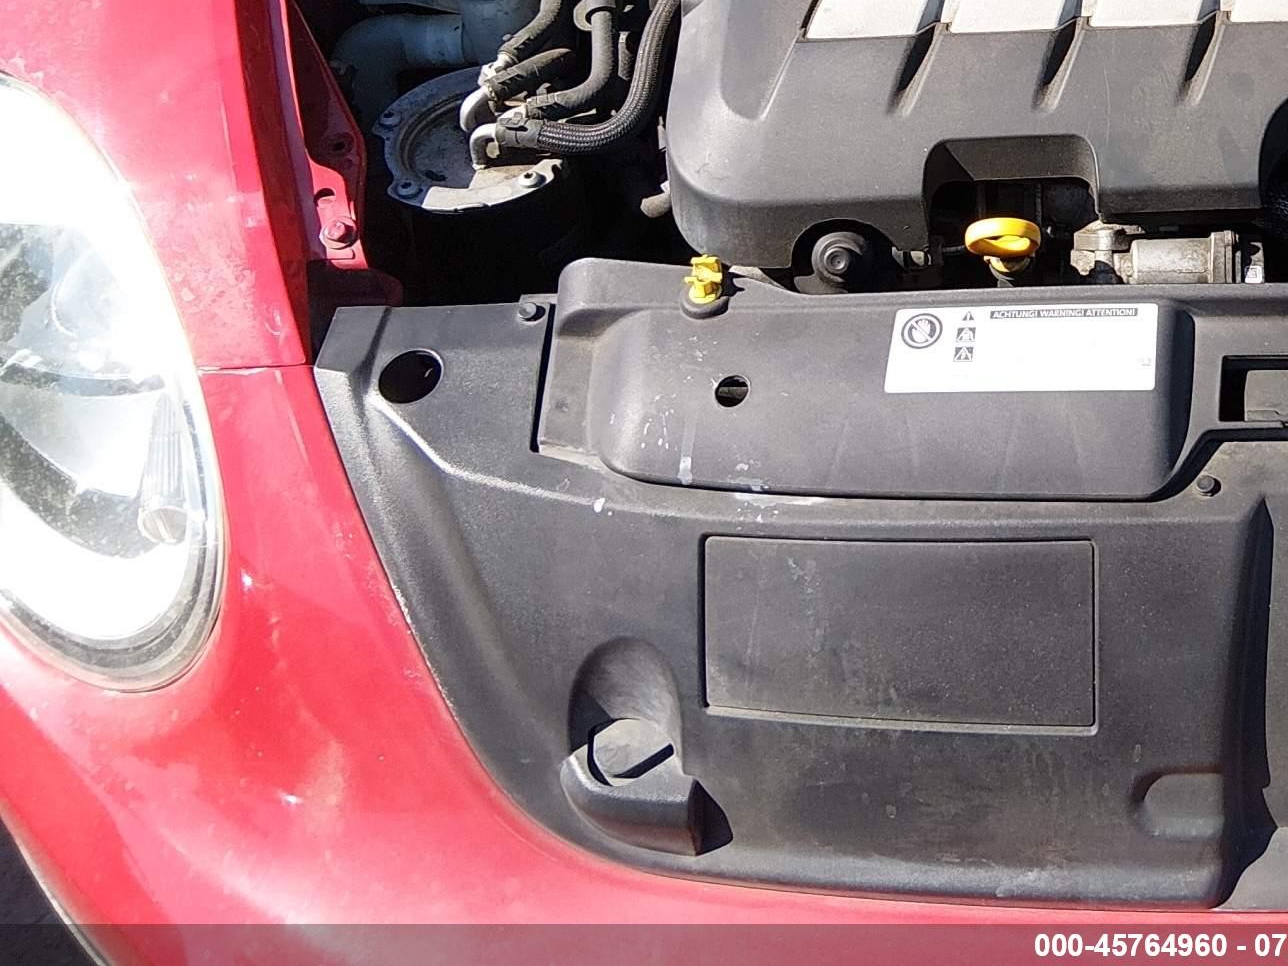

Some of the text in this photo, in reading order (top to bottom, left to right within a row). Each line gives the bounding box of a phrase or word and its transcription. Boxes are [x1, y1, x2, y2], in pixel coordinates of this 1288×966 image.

[991, 308, 1137, 319] ACHTUNG! WARNING! ATTENTION!
